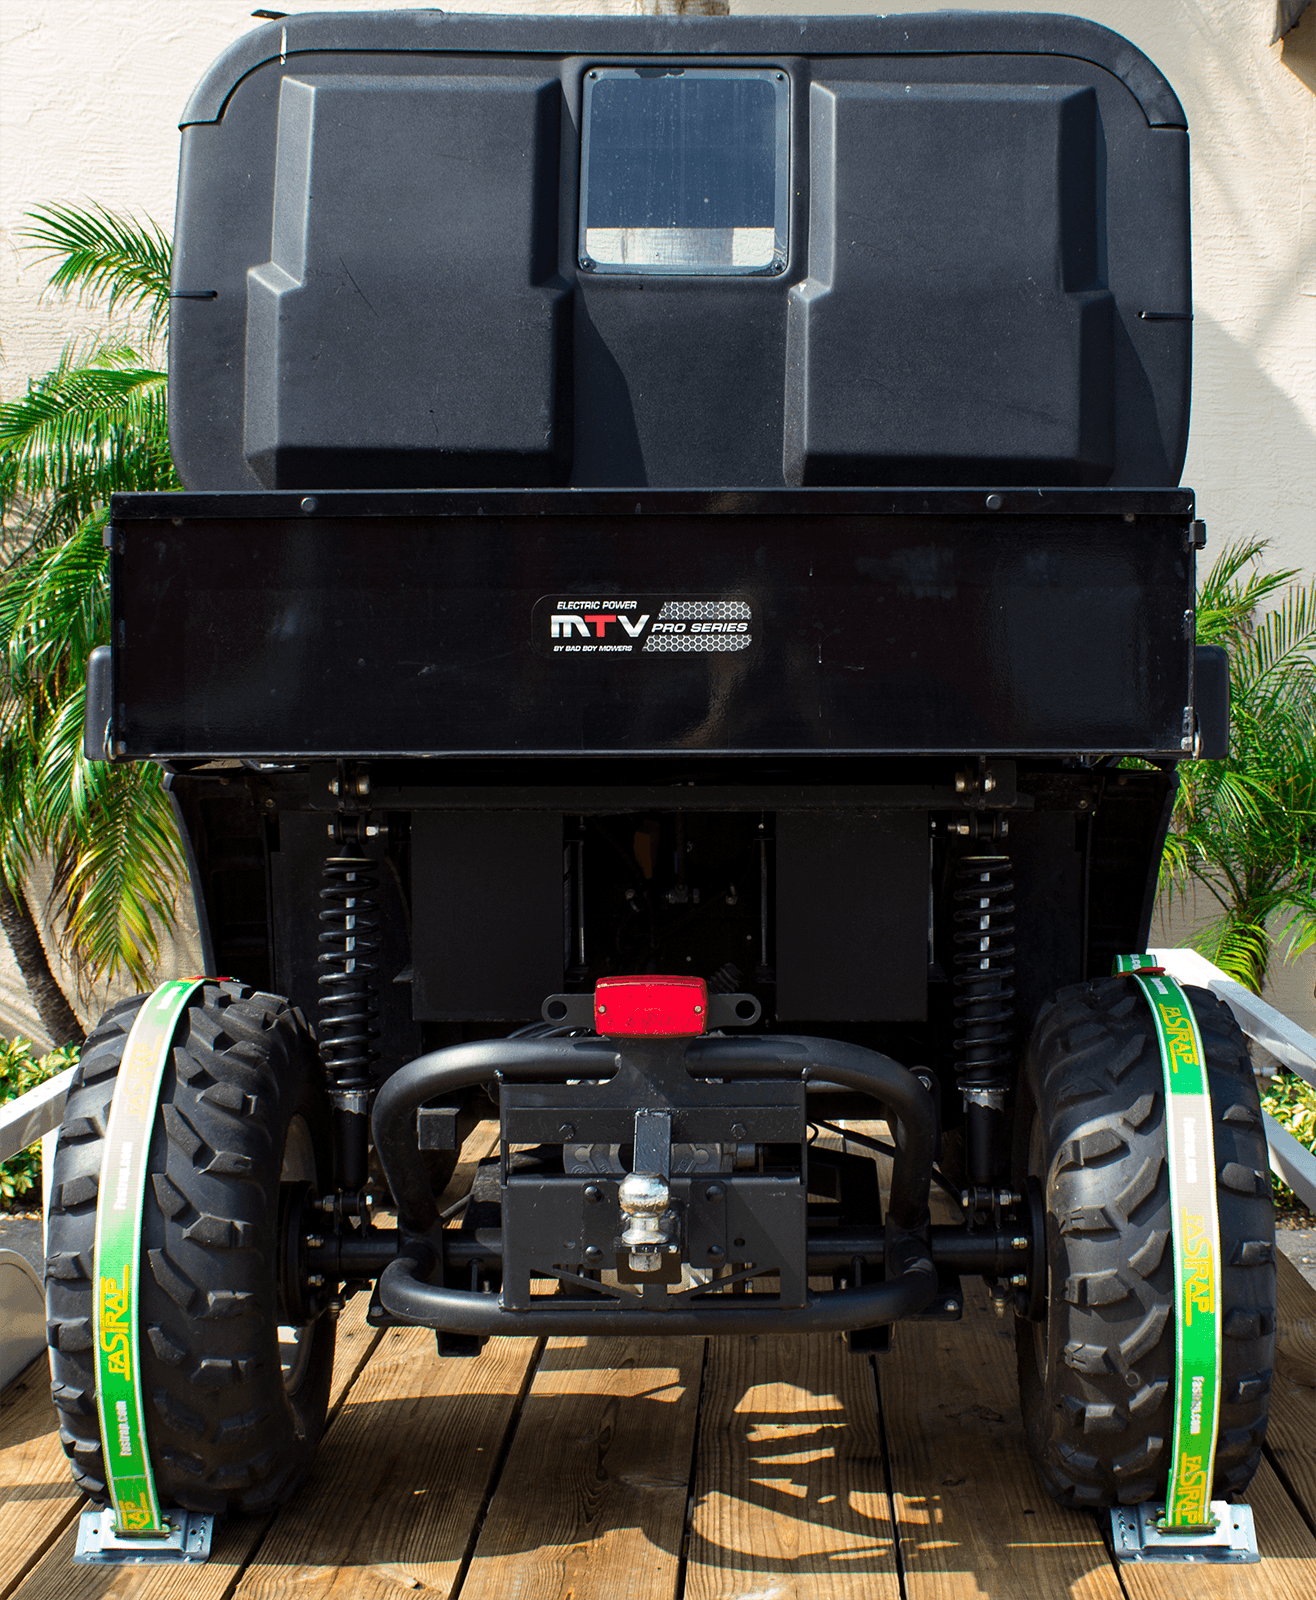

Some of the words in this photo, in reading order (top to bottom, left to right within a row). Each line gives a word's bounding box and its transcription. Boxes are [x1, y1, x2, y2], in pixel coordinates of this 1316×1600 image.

[557, 601, 601, 610] ELECTRIC
[602, 601, 637, 610] POWER
[651, 623, 686, 633] PRO
[690, 623, 749, 633] SERIES
